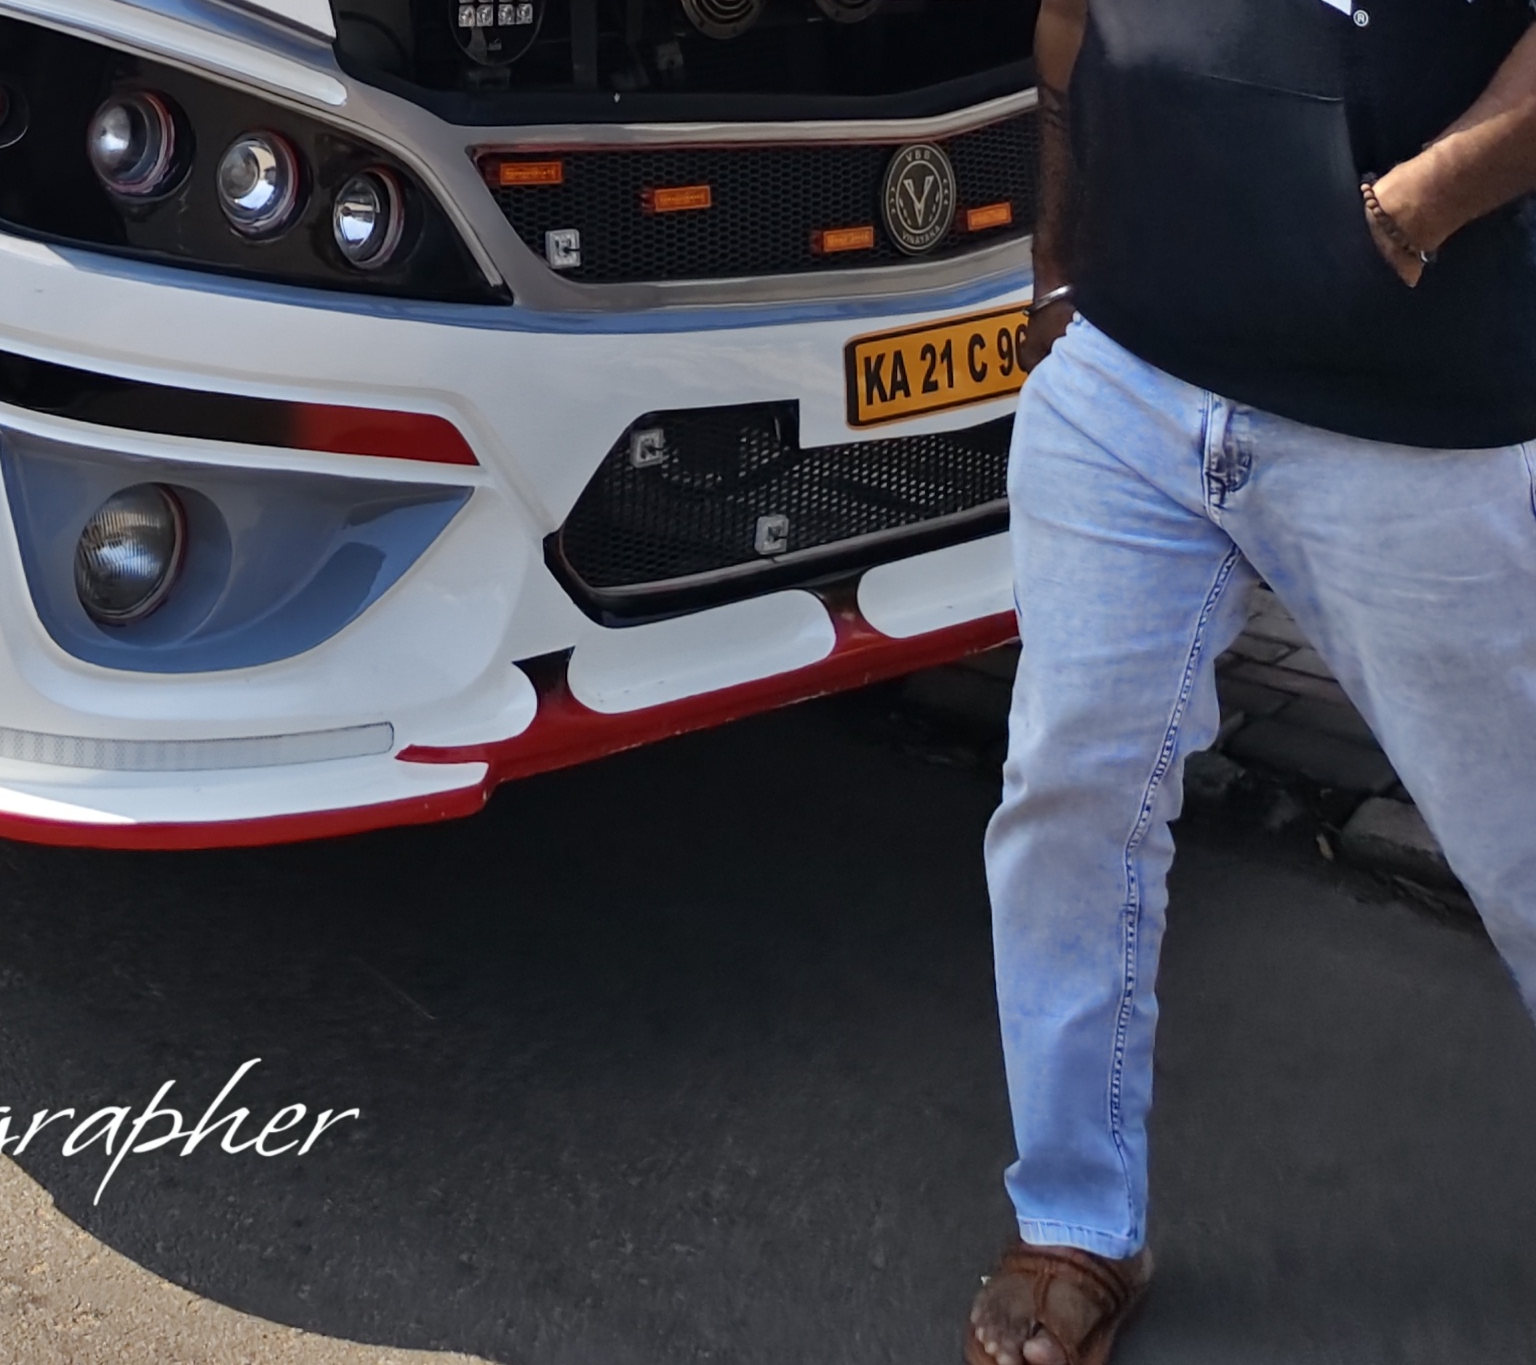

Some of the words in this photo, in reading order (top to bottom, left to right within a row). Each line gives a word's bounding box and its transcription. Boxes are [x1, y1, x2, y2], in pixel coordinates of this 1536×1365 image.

[864, 349, 912, 406] KA
[920, 338, 955, 395] 21
[967, 333, 988, 383] C
